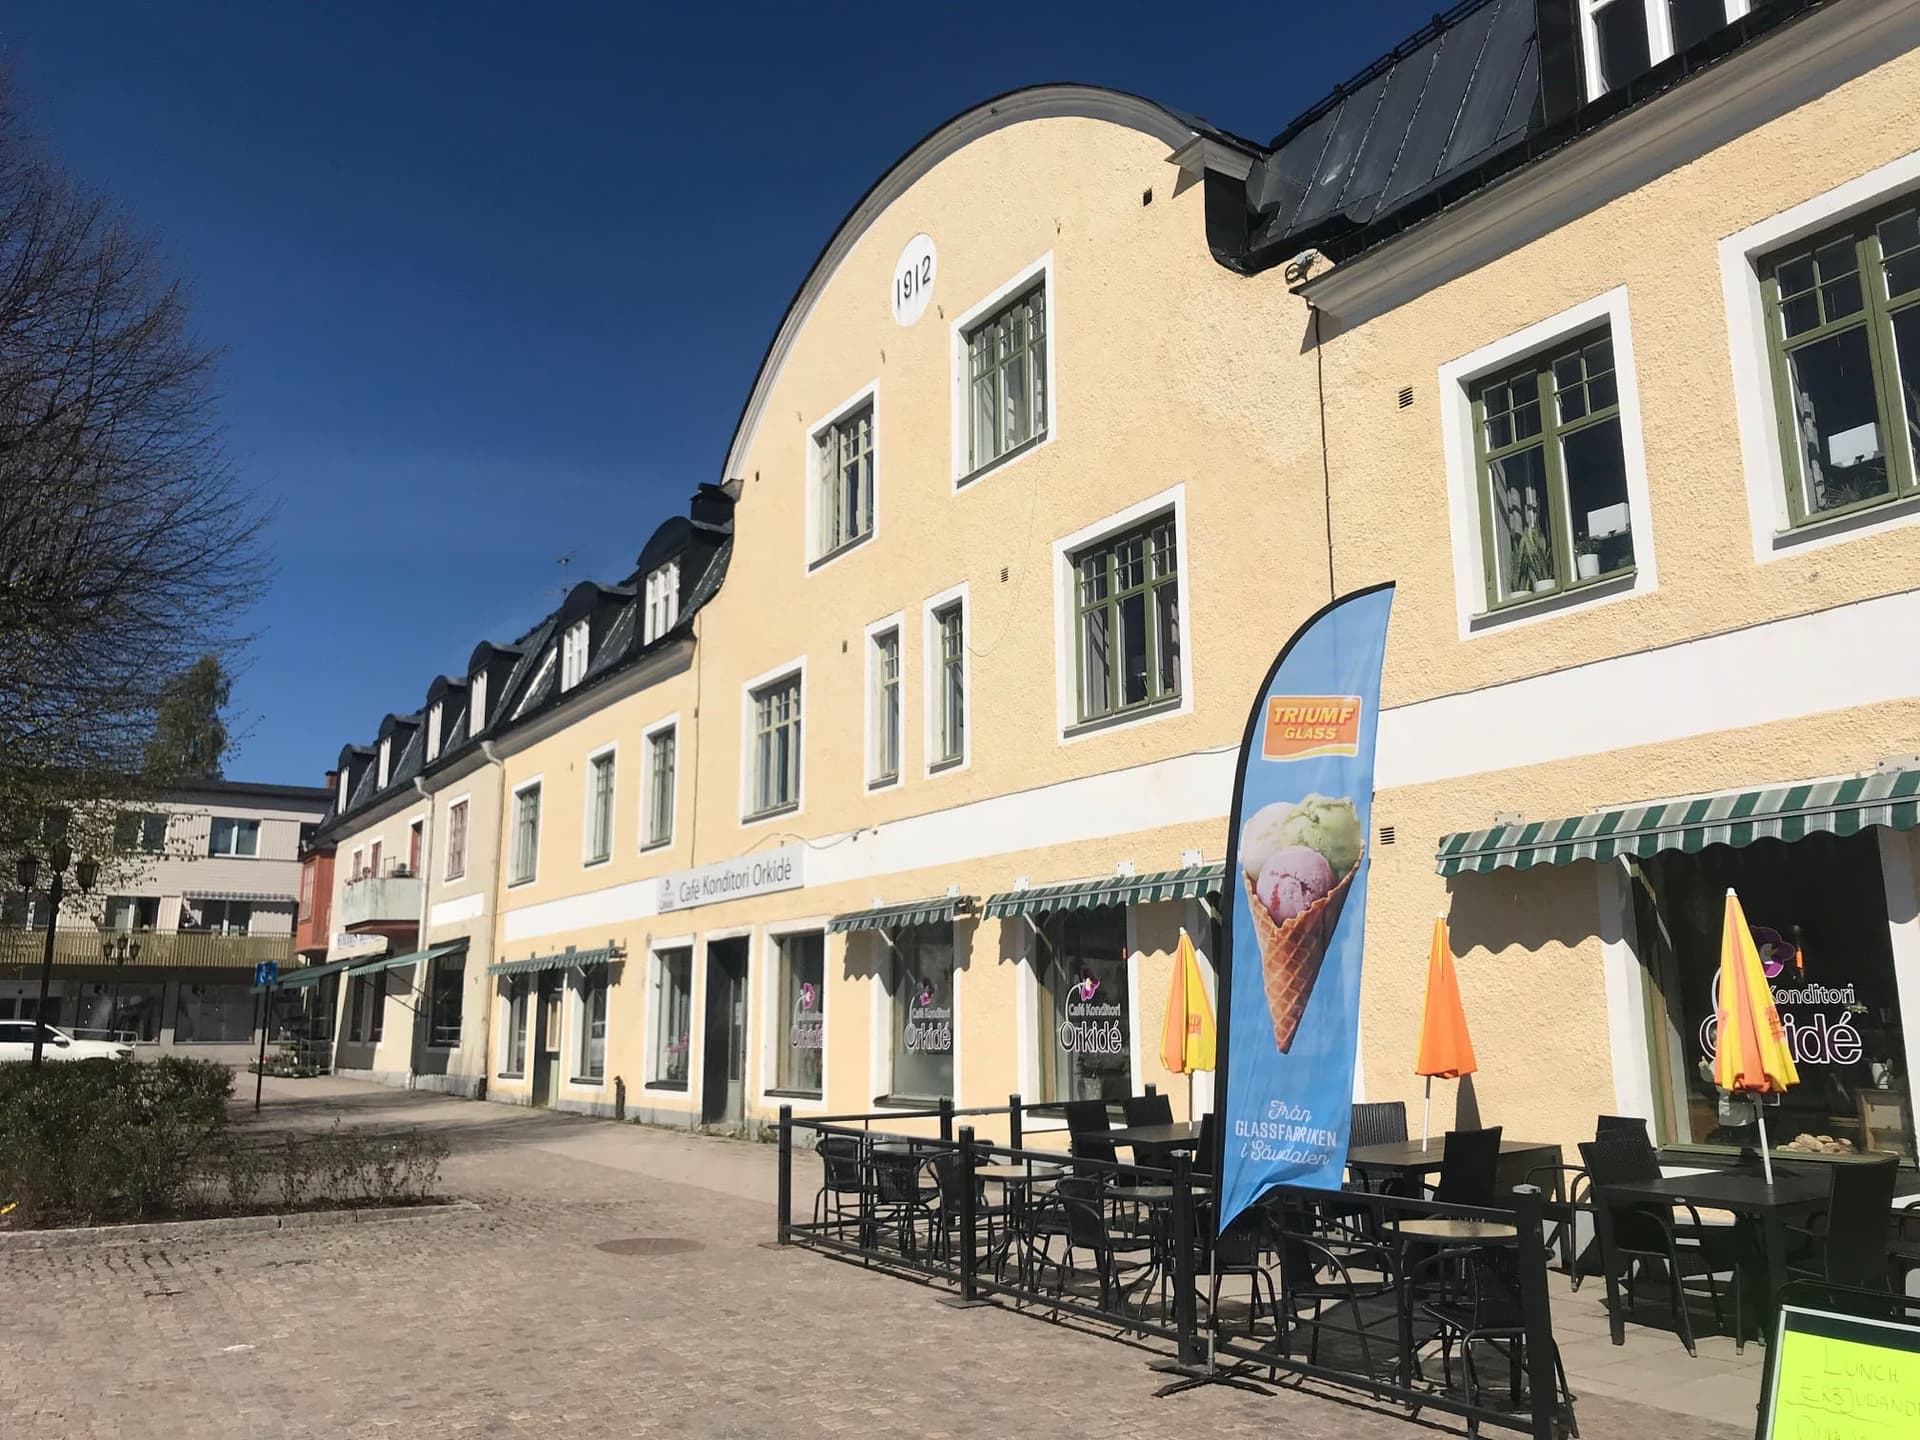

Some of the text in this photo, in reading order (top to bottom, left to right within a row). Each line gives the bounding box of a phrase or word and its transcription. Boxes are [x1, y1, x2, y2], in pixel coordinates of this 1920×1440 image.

[897, 255, 931, 309] 1912
[1274, 707, 1355, 724] TRIUMF
[1284, 727, 1337, 741] GLASS
[680, 857, 792, 902] Café Konditori Orkidé
[1069, 1003, 1121, 1017] Café Konditori
[904, 1022, 951, 1050] Orkidé
[1059, 1020, 1122, 1054] Orkidé
[1699, 1011, 1862, 1065] idé
[1268, 1100, 1312, 1122] Från
